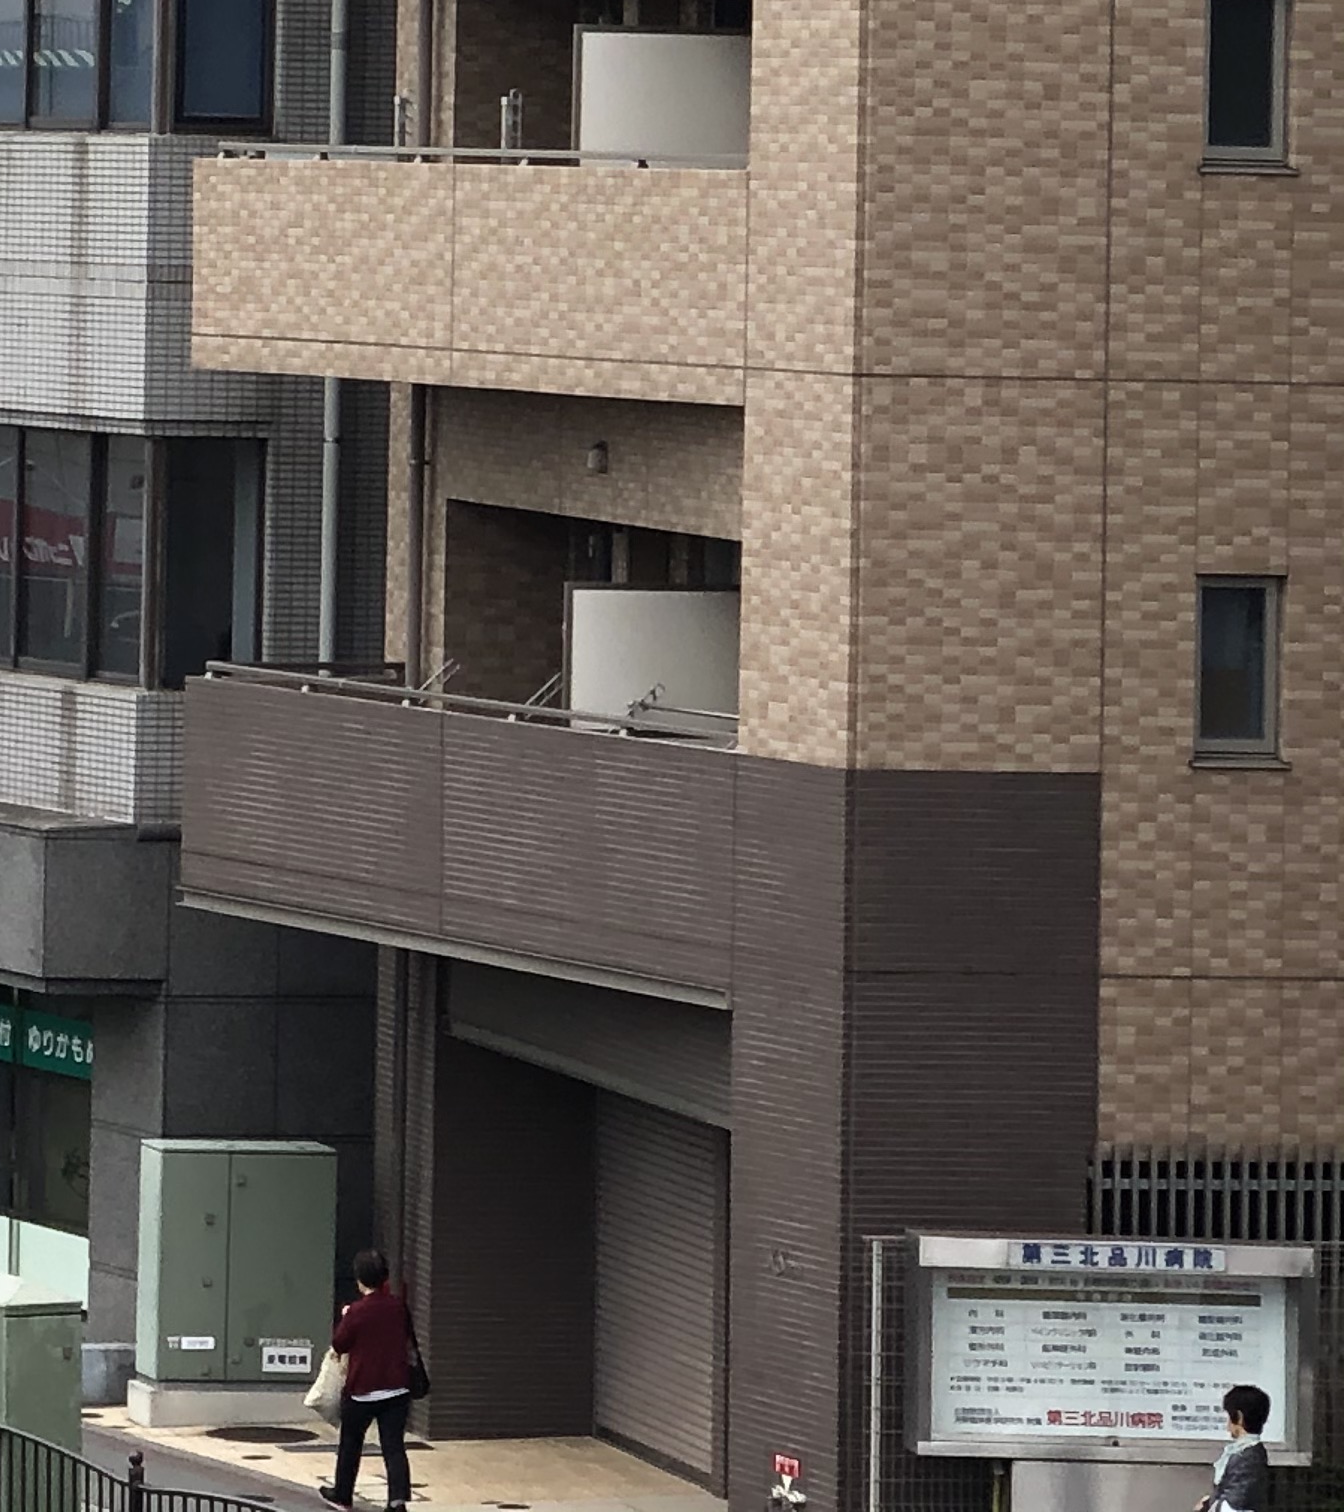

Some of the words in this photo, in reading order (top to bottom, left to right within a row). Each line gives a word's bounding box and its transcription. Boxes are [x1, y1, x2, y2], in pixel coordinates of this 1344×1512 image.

[1022, 1243, 1213, 1269] 第三北品川病院
[1046, 1409, 1164, 1429] 第三北品川病院
